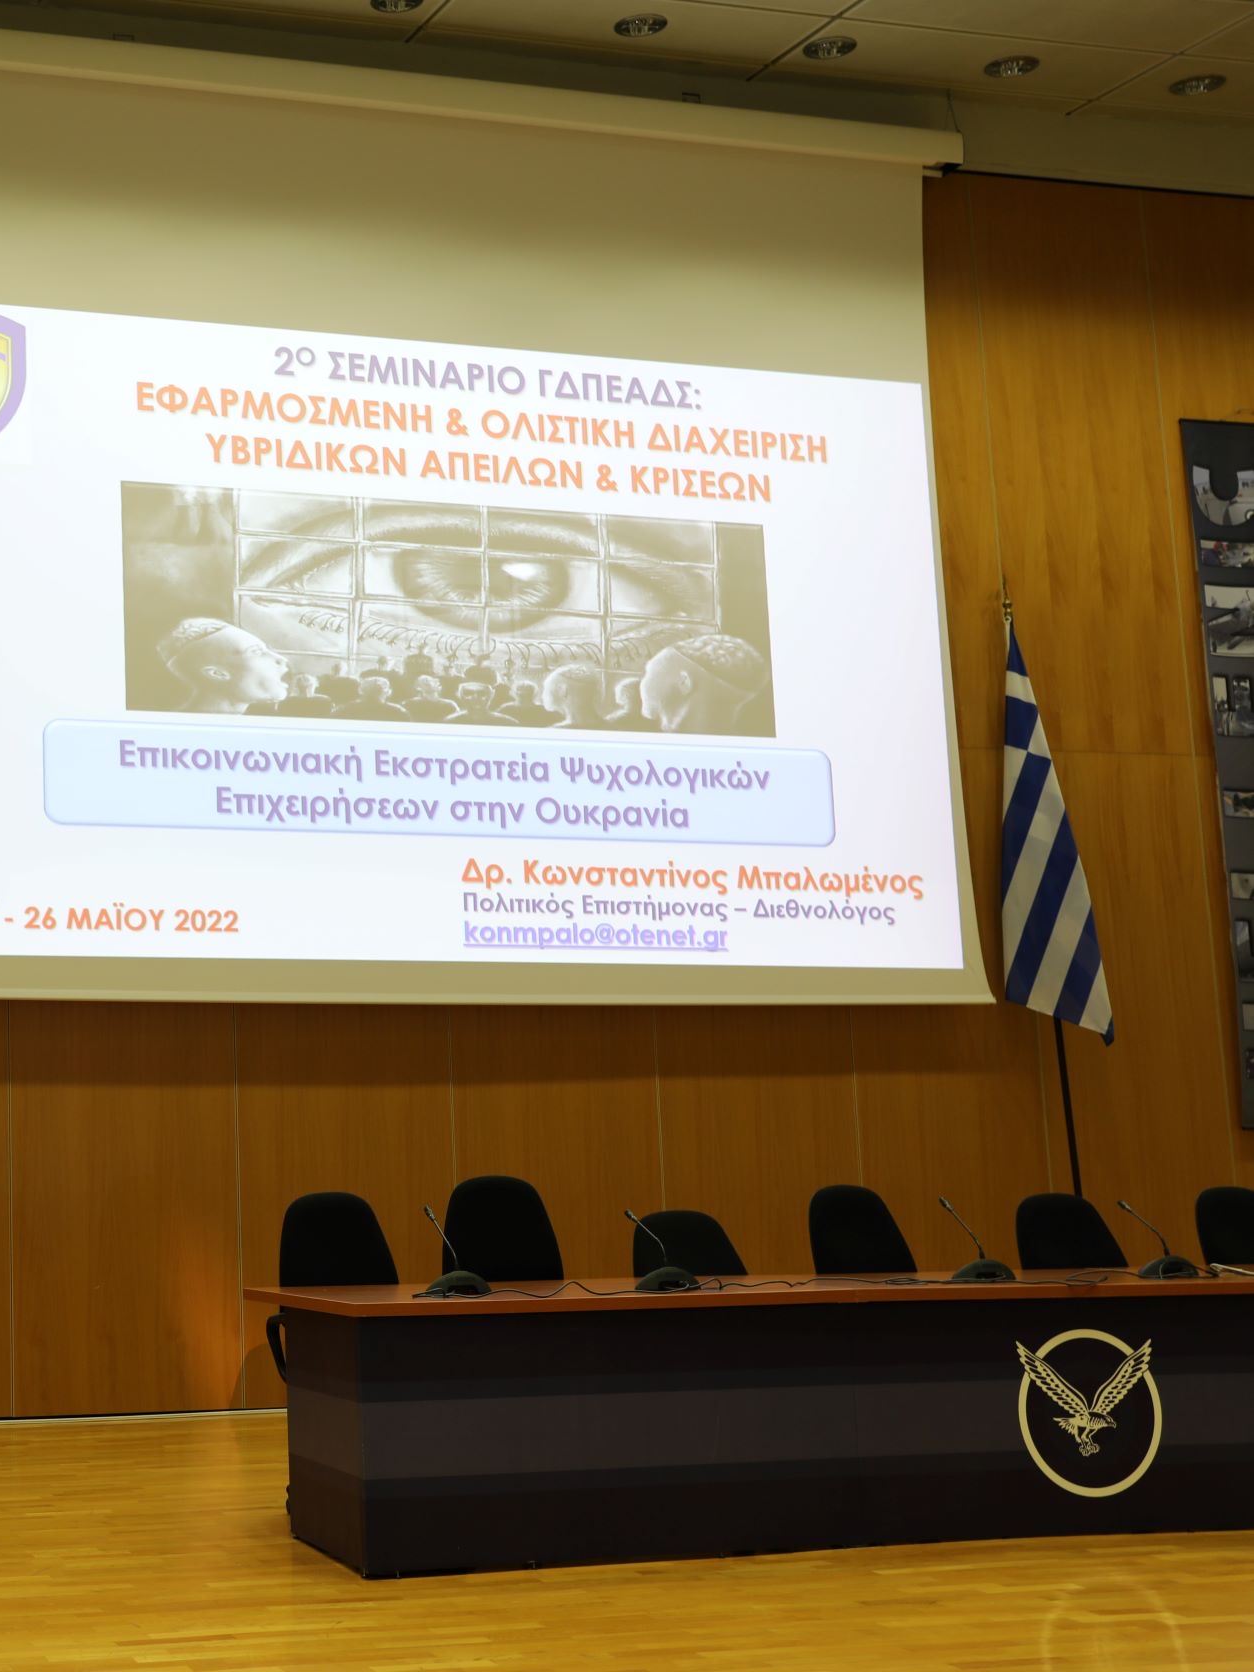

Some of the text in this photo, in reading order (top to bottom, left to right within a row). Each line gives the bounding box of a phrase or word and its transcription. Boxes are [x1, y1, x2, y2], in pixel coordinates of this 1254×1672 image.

[328, 351, 526, 396] ΣΕΜΙΝΑΡΙΟ
[539, 369, 703, 411] ΓΔΠΕΑΔΣ:
[136, 381, 829, 464] ΕΦΑΡΜΟΣΜΕΝΗ & ΟΛΙΣΤΙΚΗ ΔΙΑΧΕΙΡΙΣΗ
[205, 433, 772, 503] ΥΒΡΙΔΙΚΩΝ ΑΠΕΙΛΩΝ & ΚΡΙΣΕΩΝ
[118, 738, 770, 794] Επικοινωνιακή Εκστρατεία Ψυχολογικών
[216, 786, 690, 831] Επιχειρήσεων στην Ουκρανία
[461, 857, 924, 900] Δρ. Κωνσταντίνος Μπαλωμένος
[24, 906, 57, 930] 26
[66, 902, 165, 932] ΜΑΪΟΥ
[174, 909, 240, 933] 2022
[463, 891, 574, 919] Πολιτικός
[582, 894, 728, 922] Επιστήμονας
[753, 898, 896, 925] Διεθνολόγος
[463, 921, 729, 952] konmpalo@otenet.gr
